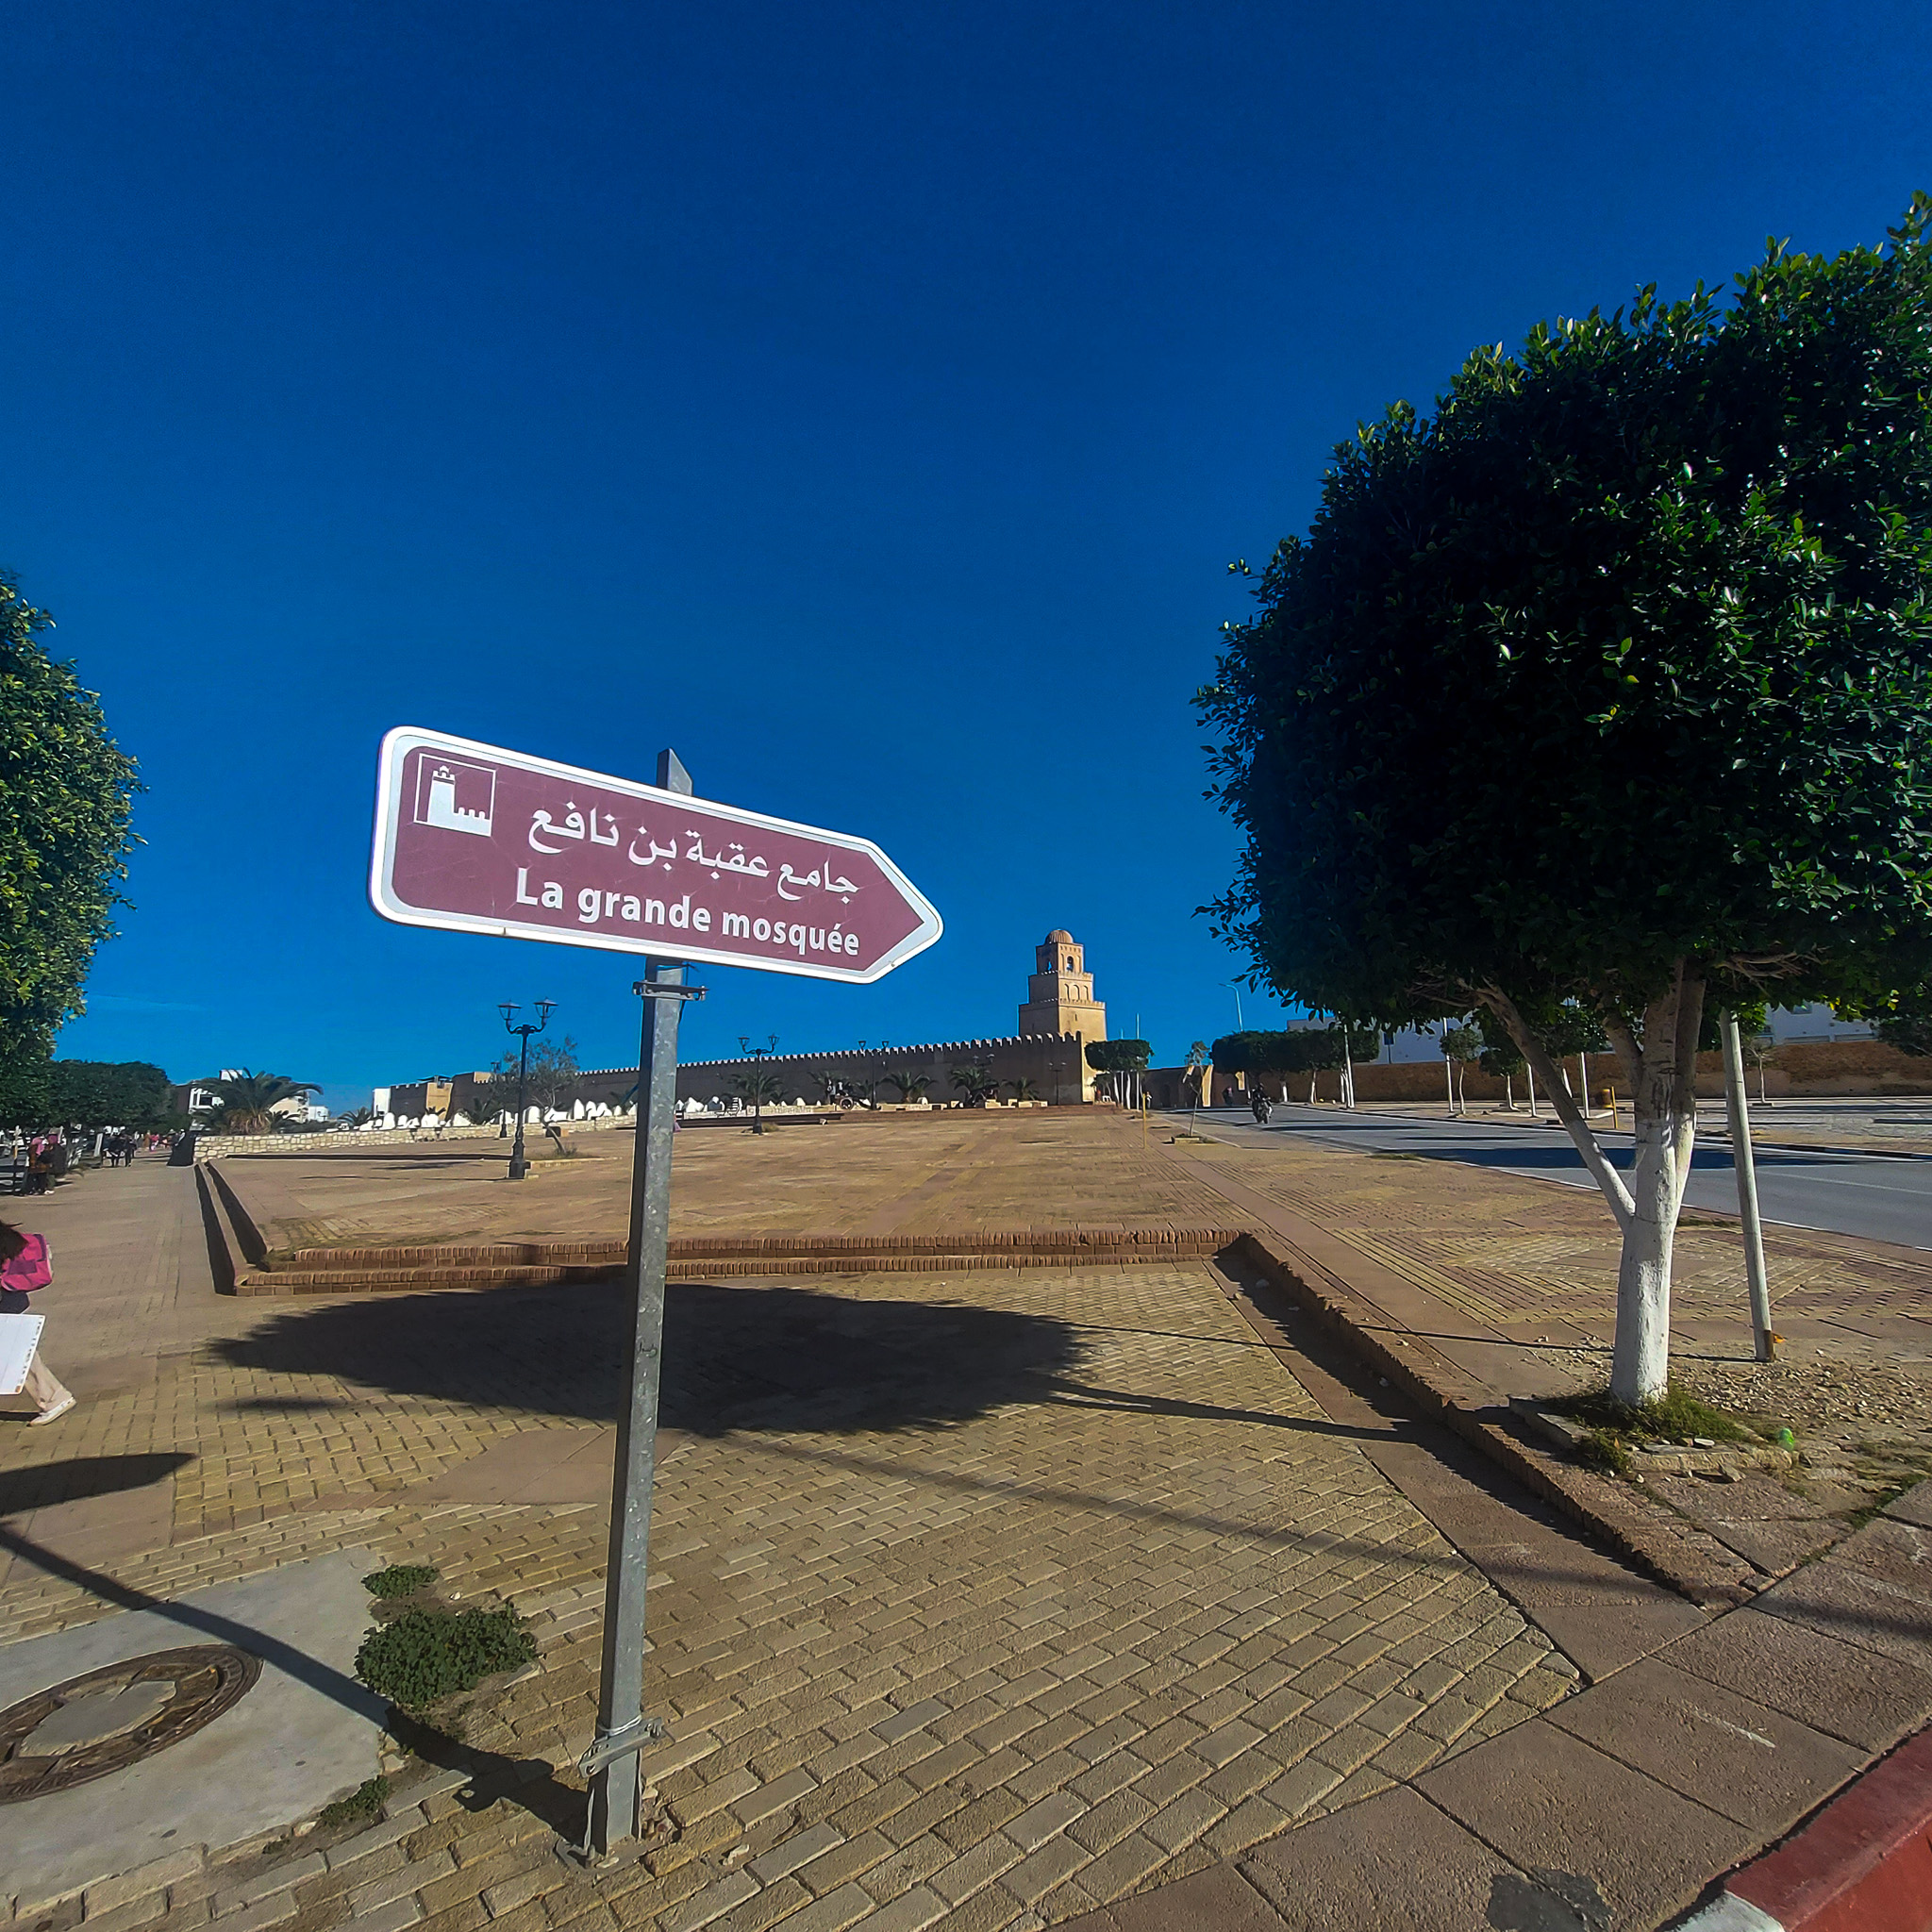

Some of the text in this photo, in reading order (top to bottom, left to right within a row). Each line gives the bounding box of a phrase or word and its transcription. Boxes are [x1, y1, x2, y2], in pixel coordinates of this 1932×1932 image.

[528, 800, 862, 905] جامع عقبة بن نافع
[515, 867, 859, 956] La grande mosquée
